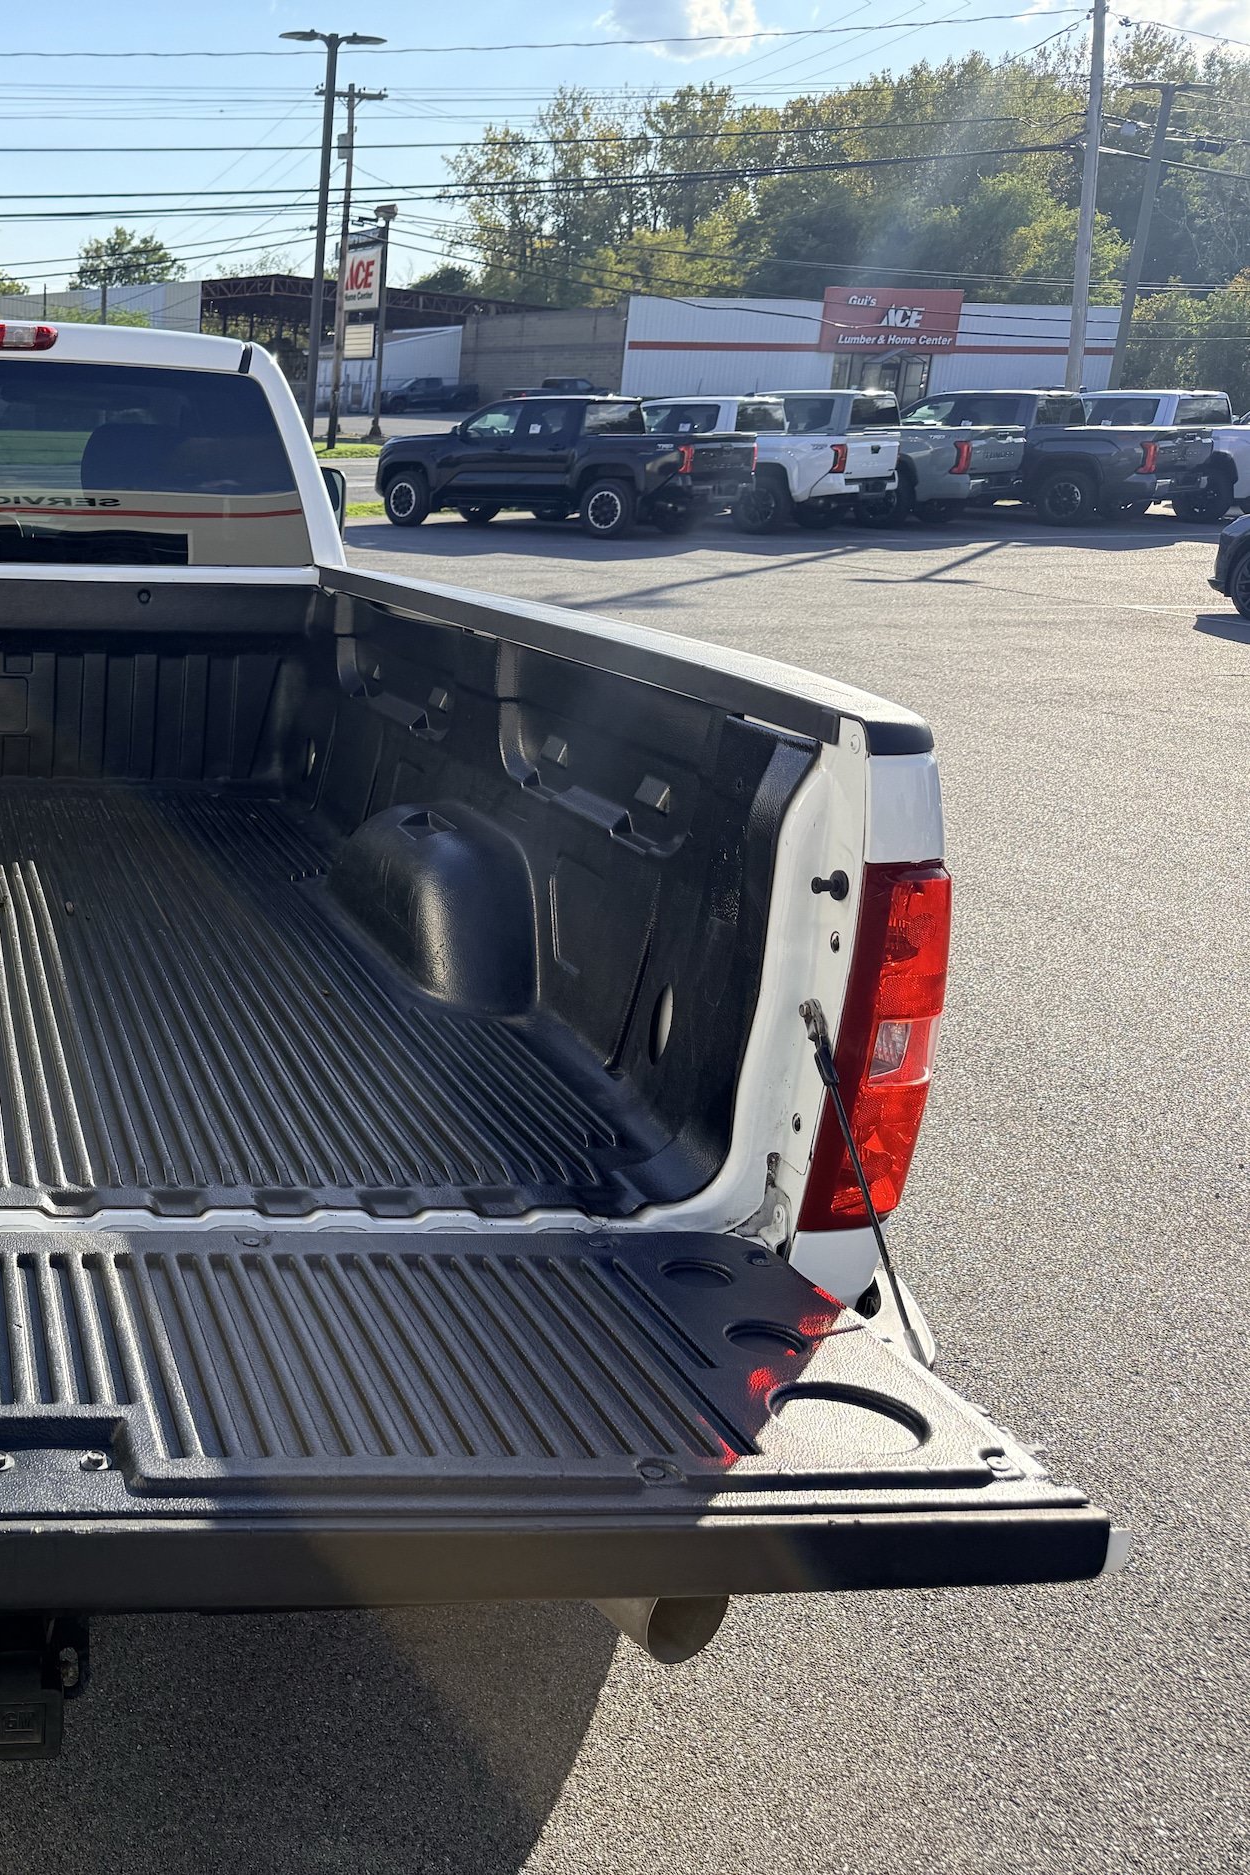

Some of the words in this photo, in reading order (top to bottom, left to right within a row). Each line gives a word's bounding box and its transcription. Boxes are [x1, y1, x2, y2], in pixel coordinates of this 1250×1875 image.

[345, 256, 375, 291] ACE
[357, 292, 373, 301] Center
[848, 295, 877, 306] Gui's
[880, 303, 925, 328] ACE
[838, 334, 876, 344] Lumber
[877, 335, 885, 344] &
[887, 335, 916, 345] Home
[919, 335, 952, 345] Center
